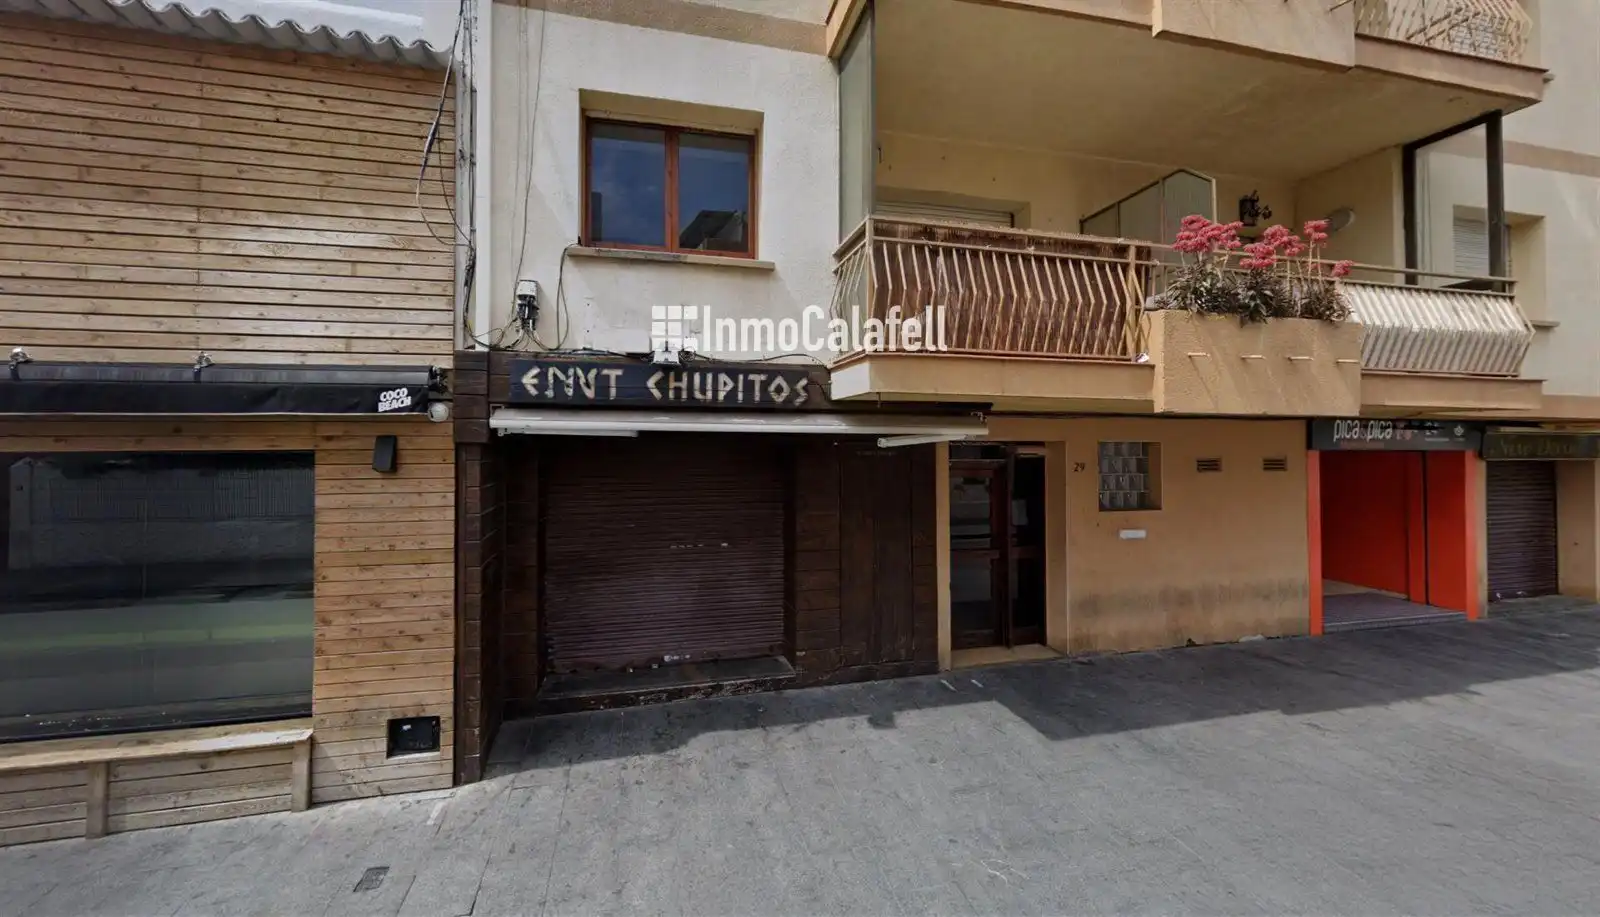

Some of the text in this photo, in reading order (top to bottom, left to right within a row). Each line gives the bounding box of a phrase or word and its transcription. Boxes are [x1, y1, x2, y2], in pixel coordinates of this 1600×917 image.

[379, 388, 408, 402] COCO
[646, 371, 810, 407] CHUPITOS
[377, 396, 411, 412] BEACH
[1072, 462, 1085, 472] 29
